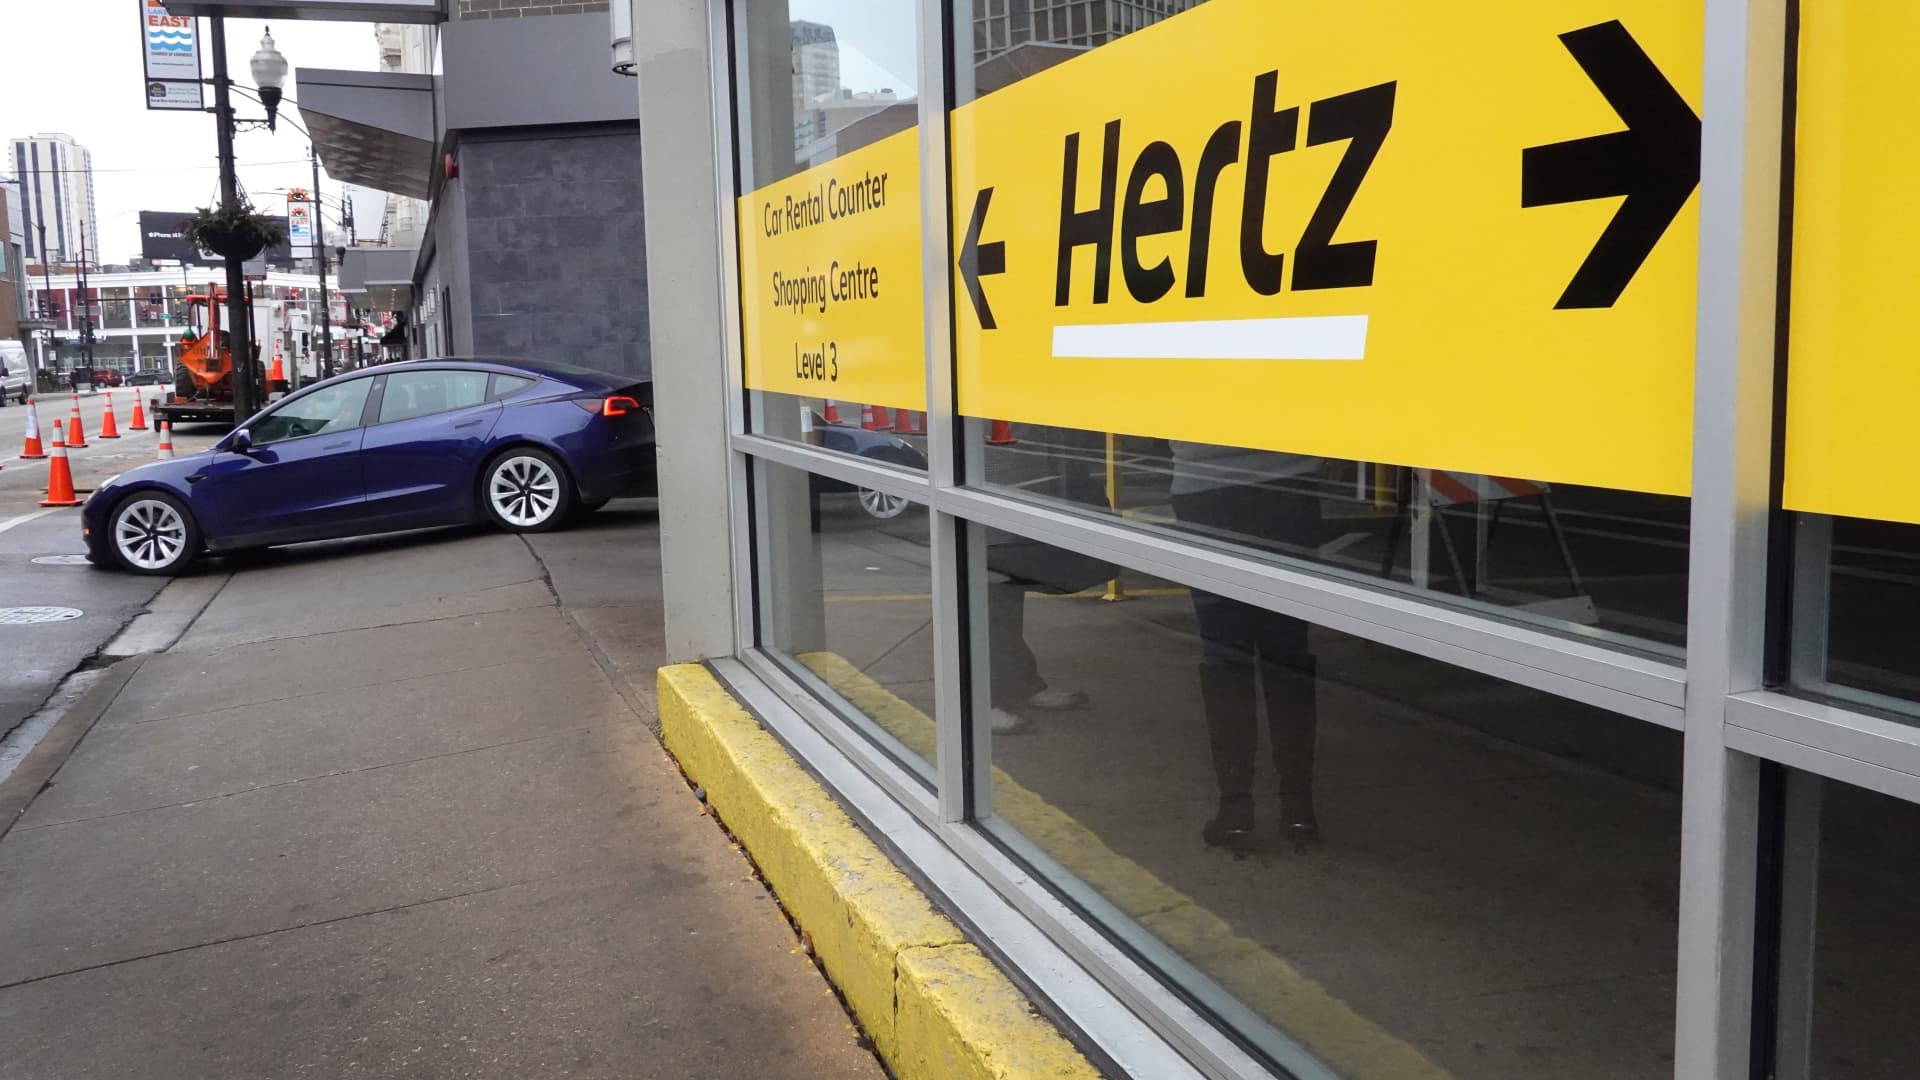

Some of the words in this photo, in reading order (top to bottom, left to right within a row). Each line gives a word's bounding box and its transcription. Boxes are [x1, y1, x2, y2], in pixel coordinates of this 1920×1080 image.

[148, 15, 190, 28] EAST
[764, 202, 783, 237] Car
[786, 183, 824, 232] Rental
[828, 171, 888, 220] Counter
[1055, 69, 1397, 307] Hertz
[772, 266, 826, 314] Shopping
[830, 260, 879, 302] Centre
[795, 342, 826, 381] Level
[829, 341, 838, 382] 3
